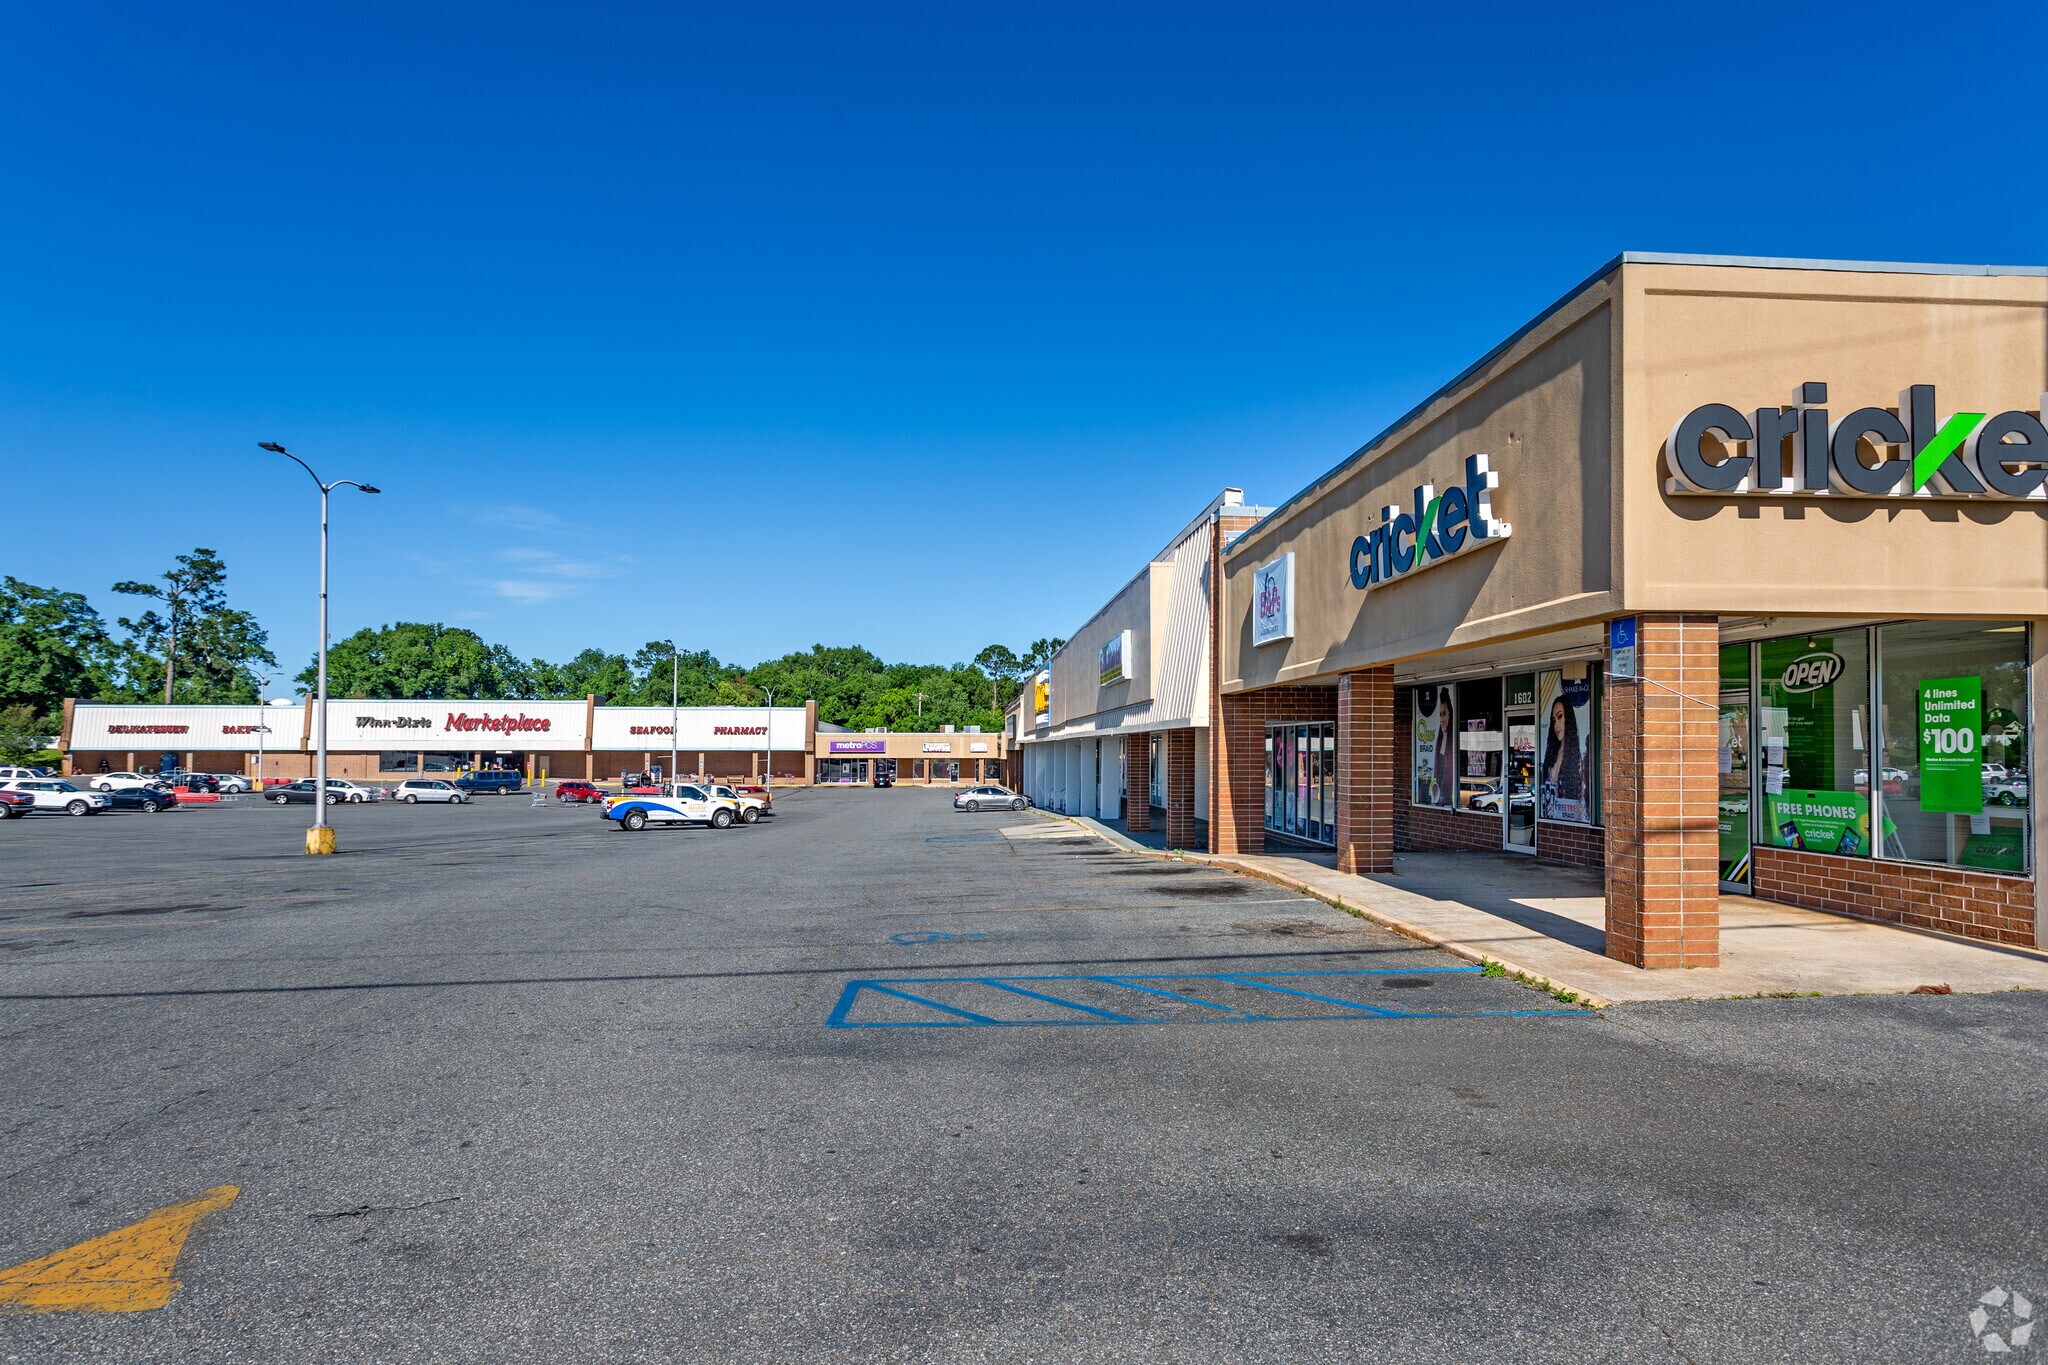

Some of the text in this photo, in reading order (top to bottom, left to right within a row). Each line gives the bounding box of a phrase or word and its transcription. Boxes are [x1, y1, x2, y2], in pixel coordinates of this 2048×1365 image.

[1667, 382, 2048, 496] cricke
[1350, 454, 1498, 591] cricket
[1784, 660, 1834, 686] OPEN
[1514, 692, 1532, 705] 1602
[1924, 689, 1958, 699] 4 lines
[1924, 699, 1975, 711] Unlimited
[355, 716, 432, 728] Winn-Dixie
[1924, 713, 1951, 723] Data
[107, 725, 189, 734] DELICATESSEN
[444, 713, 551, 735] Marketplace
[713, 726, 768, 735] PHARMACY
[836, 741, 877, 749] metroPCS
[1923, 728, 1974, 754] $100
[1420, 745, 1433, 753] BRAID
[1561, 812, 1576, 820] BRAID
[1777, 802, 1857, 820] FREE PHONES
[1805, 829, 1835, 840] cricket
[1976, 845, 2017, 856] cricket
